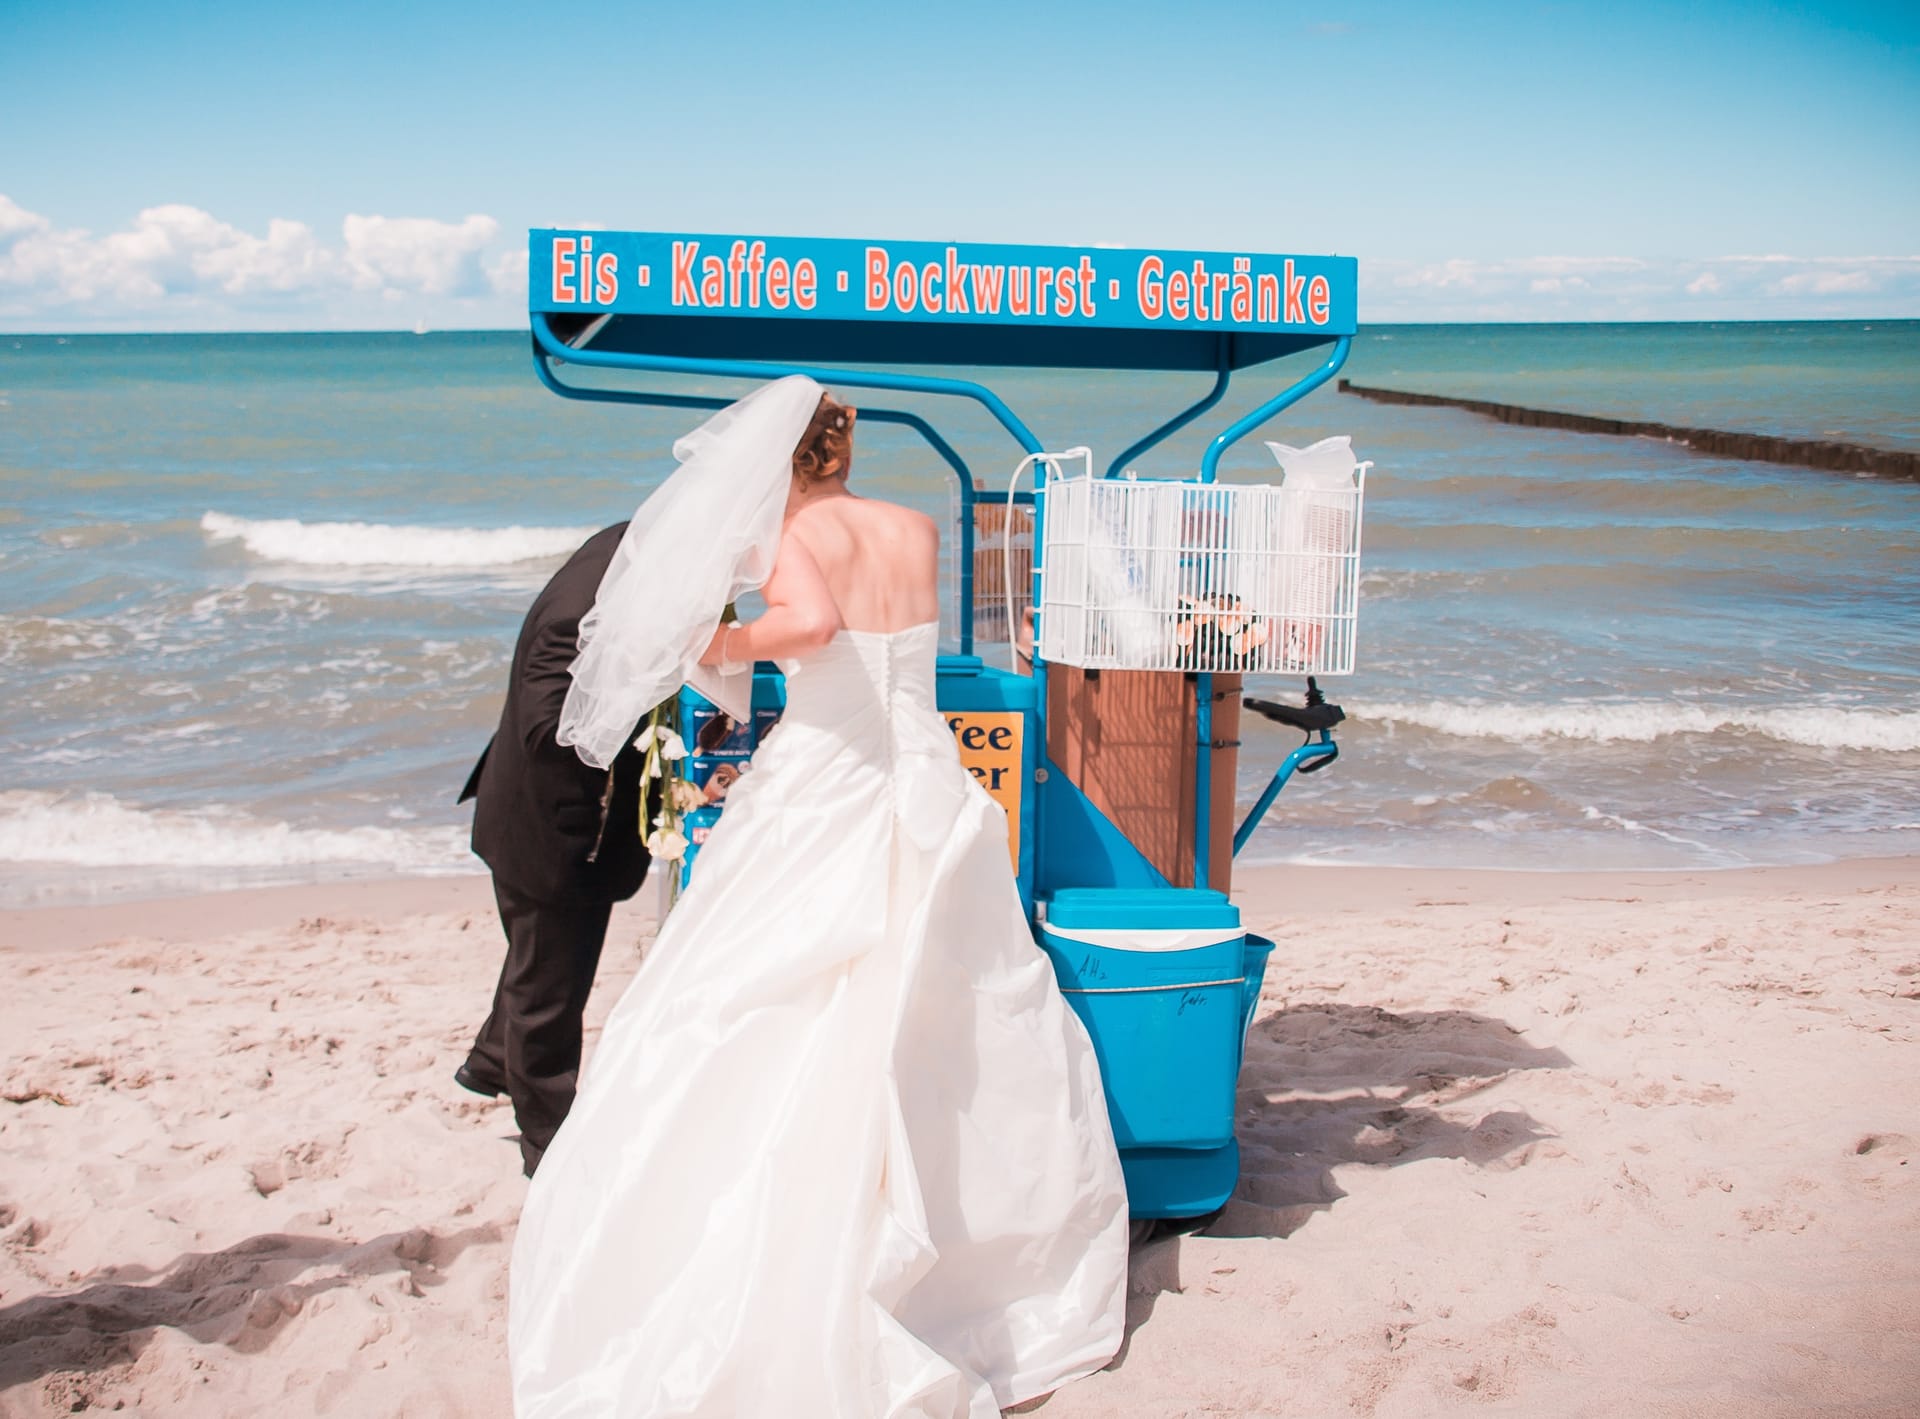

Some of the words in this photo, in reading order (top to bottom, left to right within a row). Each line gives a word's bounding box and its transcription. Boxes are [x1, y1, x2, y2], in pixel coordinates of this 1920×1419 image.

[552, 236, 618, 305] Eis
[671, 240, 817, 310] Kaffee
[864, 246, 1096, 318] Bockwurst
[1137, 255, 1330, 325] Getränke
